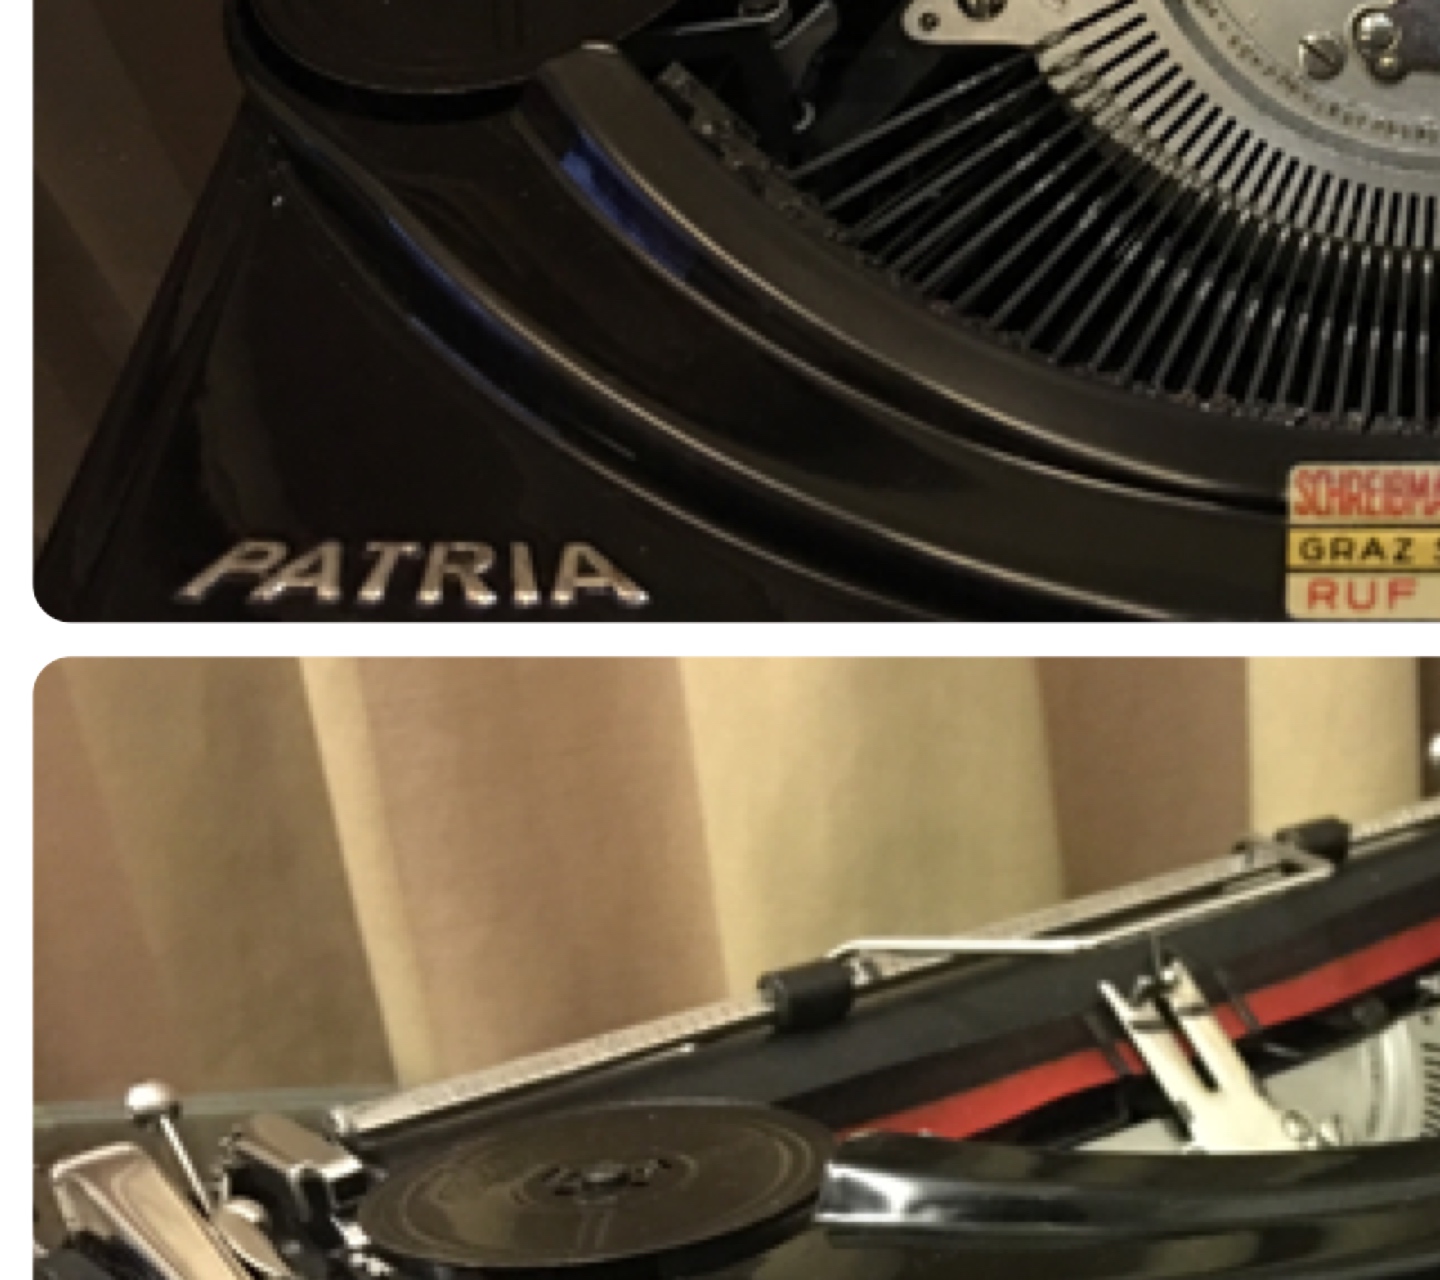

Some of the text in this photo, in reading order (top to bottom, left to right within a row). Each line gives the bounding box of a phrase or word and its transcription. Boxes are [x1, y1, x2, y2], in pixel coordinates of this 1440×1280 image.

[1299, 536, 1417, 564] GRAZ
[168, 535, 652, 606] PATRIA
[1304, 578, 1418, 613] RUF
